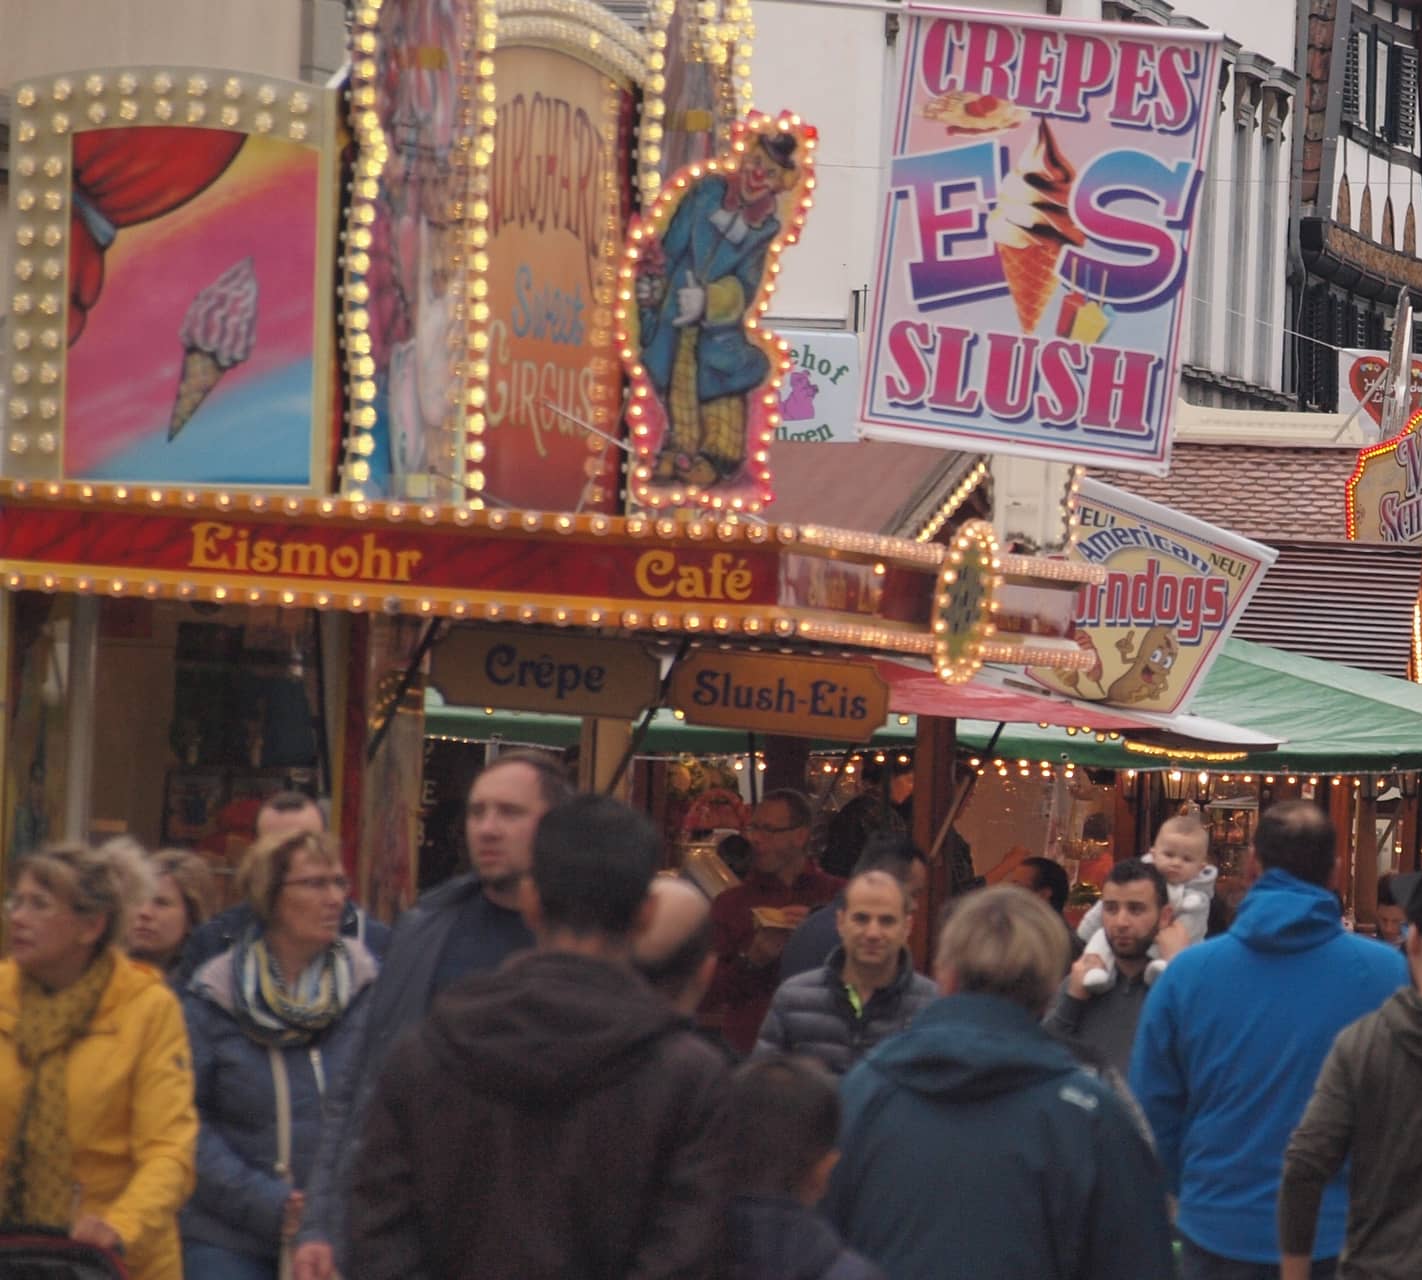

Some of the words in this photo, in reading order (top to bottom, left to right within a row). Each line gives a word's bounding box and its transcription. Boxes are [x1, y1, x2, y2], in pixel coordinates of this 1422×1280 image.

[921, 18, 1200, 135] CREPES
[890, 139, 1204, 313] ES
[788, 344, 849, 385] ehof
[885, 319, 1162, 439] SLUSH
[1077, 505, 1115, 529] EU!
[187, 522, 422, 581] Eismohr
[634, 549, 753, 600] Café
[1076, 524, 1211, 574] American
[1208, 552, 1247, 581] NEU!
[484, 644, 607, 698] Crêpe
[692, 671, 868, 720] Slush-Eis
